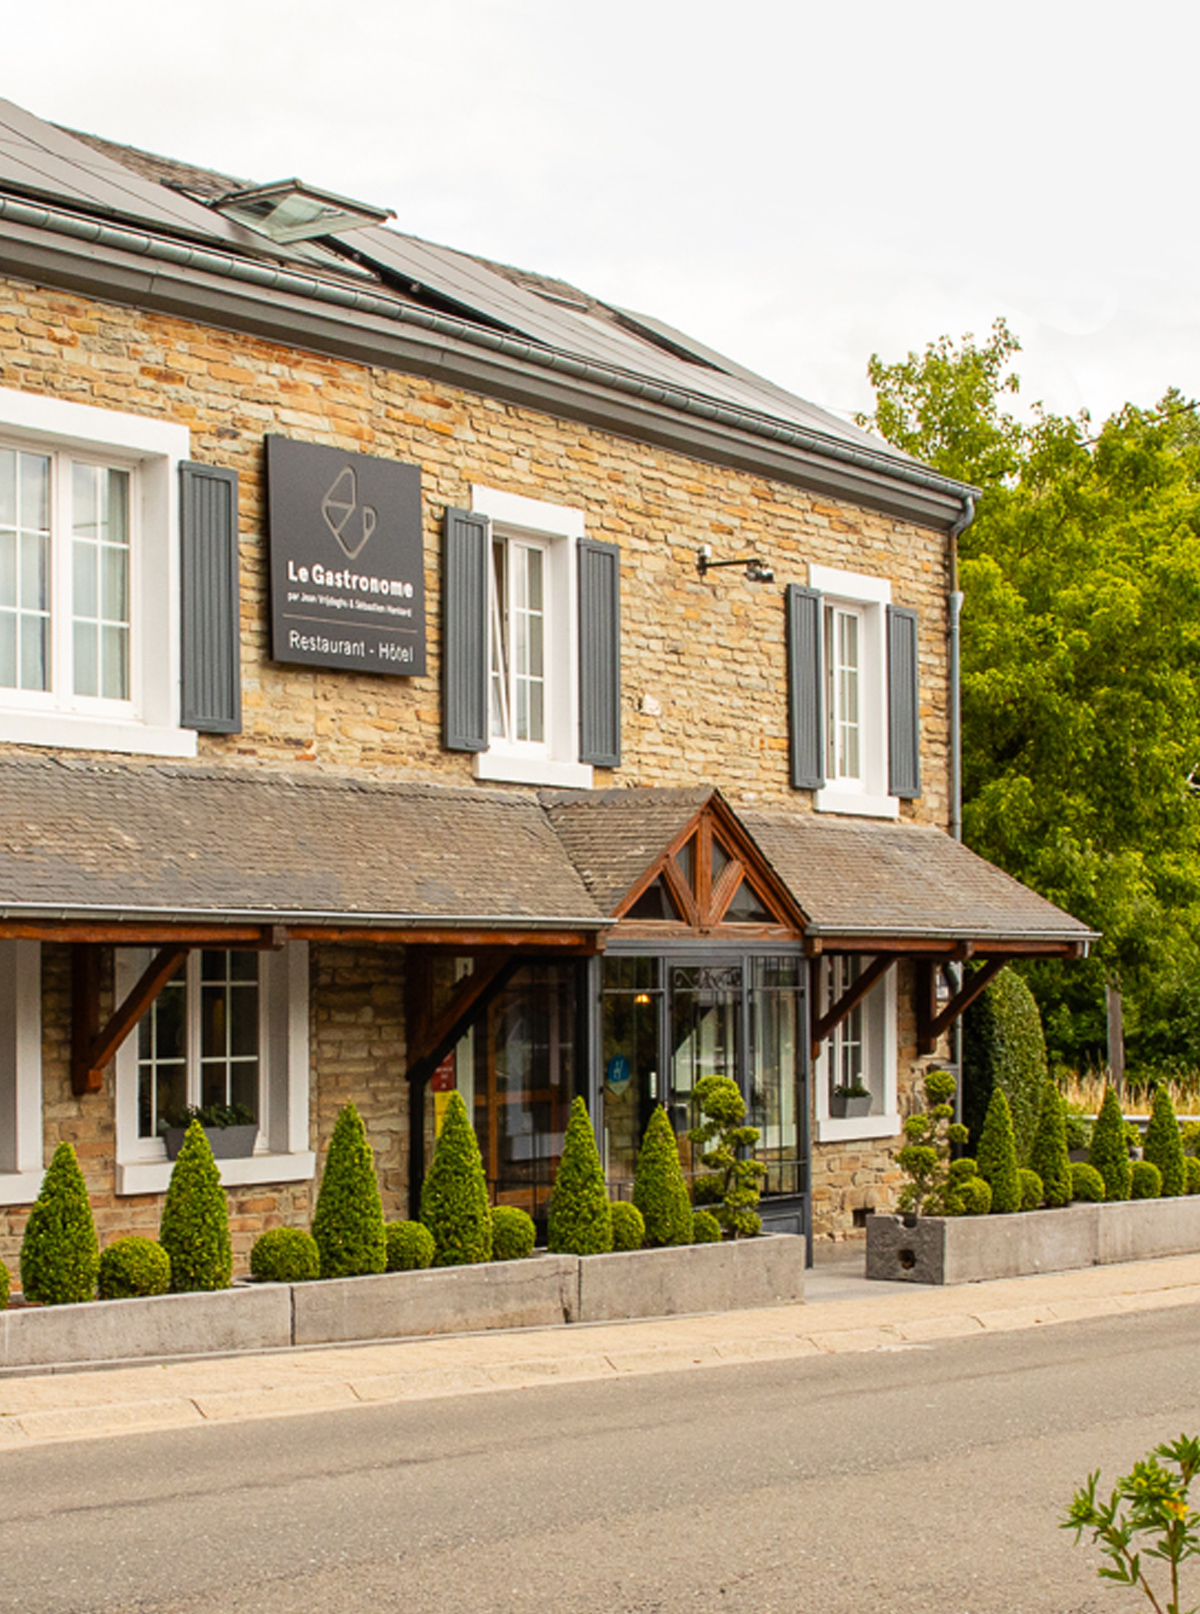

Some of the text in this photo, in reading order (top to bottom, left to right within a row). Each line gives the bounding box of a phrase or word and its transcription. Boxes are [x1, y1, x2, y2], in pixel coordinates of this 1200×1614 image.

[287, 559, 413, 598] Le Gastronome
[288, 628, 365, 658] Restaurant
[378, 641, 413, 663] Hôtel
